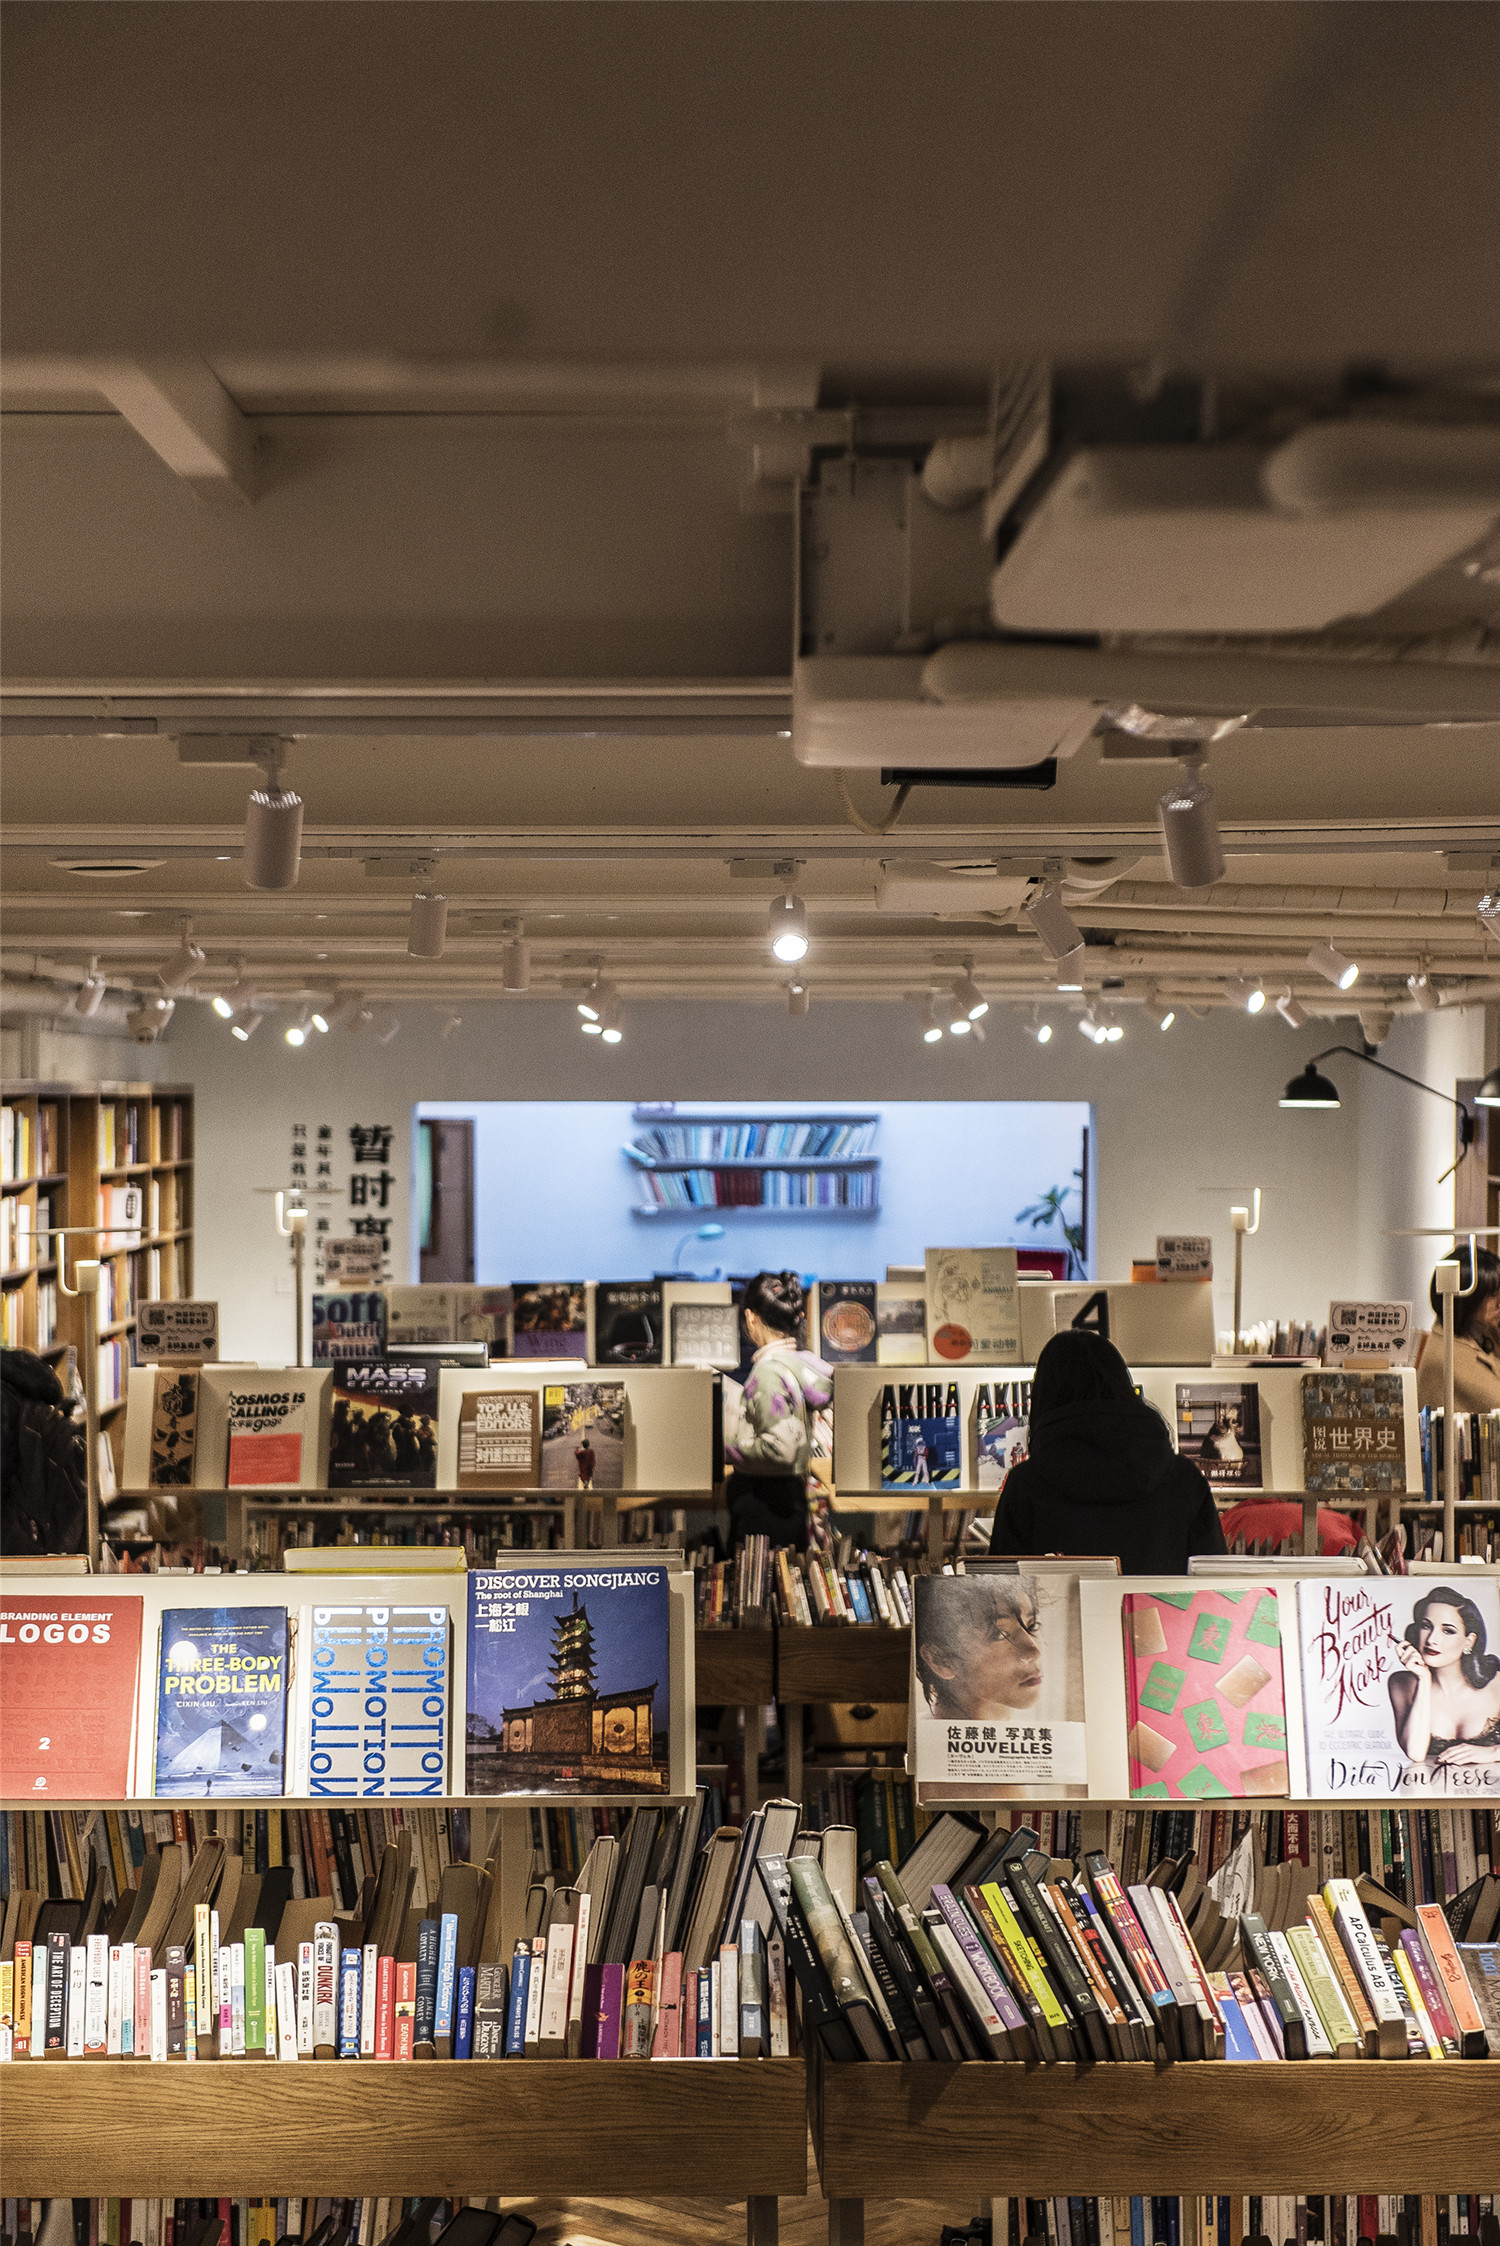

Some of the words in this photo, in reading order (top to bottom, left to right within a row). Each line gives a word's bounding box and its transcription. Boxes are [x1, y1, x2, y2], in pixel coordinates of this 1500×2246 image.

[347, 1367, 427, 1380] MASS
[292, 1392, 306, 1404] IS
[478, 1402, 504, 1413] TOP
[507, 1402, 532, 1413] U.S.
[882, 1381, 960, 1420] AKIRA
[977, 1380, 1032, 1419] AKIR
[477, 1420, 532, 1429] EDITORS
[1329, 1427, 1397, 1451] 世界史
[475, 1574, 560, 1590] DISCOVER
[564, 1572, 660, 1589] SONGJIANG
[475, 1591, 493, 1600] The
[494, 1592, 512, 1600] root
[513, 1591, 522, 1599] of
[523, 1590, 563, 1600] Shanghai
[0, 1612, 58, 1621] BRANDING
[61, 1613, 113, 1621] ELEMENT
[475, 1602, 529, 1618] 上海之根
[1324, 1586, 1372, 1639] Your
[0, 1623, 111, 1644] LOGOS
[1309, 1603, 1393, 1682] Beauty
[211, 1643, 238, 1654] THE
[165, 1655, 283, 1673] THREE-BODY
[164, 1673, 281, 1694] PROBLEM
[1325, 1646, 1391, 1725] Mark
[363, 1606, 390, 1797] PROMOTION
[38, 1736, 51, 1751] 2
[947, 1725, 997, 1741] 佐藤健
[1005, 1727, 1053, 1741] 写真集
[947, 1741, 1053, 1755] NOUVELLES
[1327, 1757, 1384, 1790] Dita
[1377, 1759, 1430, 1793] Von
[1430, 1759, 1500, 1794] Teese
[1287, 1813, 1299, 1854] 大而不倒
[1020, 1878, 1035, 1898] WORLD
[1034, 1905, 1053, 1933] WARCRAFT
[981, 1909, 992, 1923] Color
[990, 1928, 1006, 1945] Light
[1349, 1916, 1364, 1930] AP
[317, 1942, 325, 1955] VOICES
[325, 1941, 333, 1964] FORGOTTEN
[419, 1932, 428, 1962] LOYALTY
[428, 1935, 436, 1965] HIGHER
[939, 1893, 960, 1919] BRAIN
[952, 1916, 976, 1941] QUEST
[970, 1950, 1009, 2001] WORKBOOK
[1013, 1940, 1034, 1971] SKETCHING
[1253, 1932, 1270, 1955] NEW
[1355, 1931, 1376, 1971] Calculus
[52, 1951, 64, 1963] THE
[862, 1932, 898, 1996] UNFLATTENING
[1261, 1955, 1280, 1982] YORK
[1479, 1952, 1499, 1976] 1001
[51, 1966, 63, 1978] ART
[51, 1979, 63, 1988] OF
[441, 1962, 453, 1981] English
[480, 1967, 494, 2000] MARTIN
[633, 1961, 650, 1990] 鹿の王
[1371, 1975, 1386, 1988] AB
[317, 1965, 333, 2005] DUNKIRK
[439, 1982, 452, 2012] Dictionary
[49, 1991, 62, 2028] DECEPTION
[416, 1996, 425, 2022] COMEY
[425, 1996, 433, 2020] JAMES
[1351, 1991, 1372, 2019] WOMEN
[400, 2022, 408, 2041] DEATH
[491, 2025, 501, 2043] DANCE
[1303, 2008, 1321, 2040] PLAYBOOK
[400, 2043, 408, 2055] NILE
[480, 2021, 492, 2053] DRAGONS
